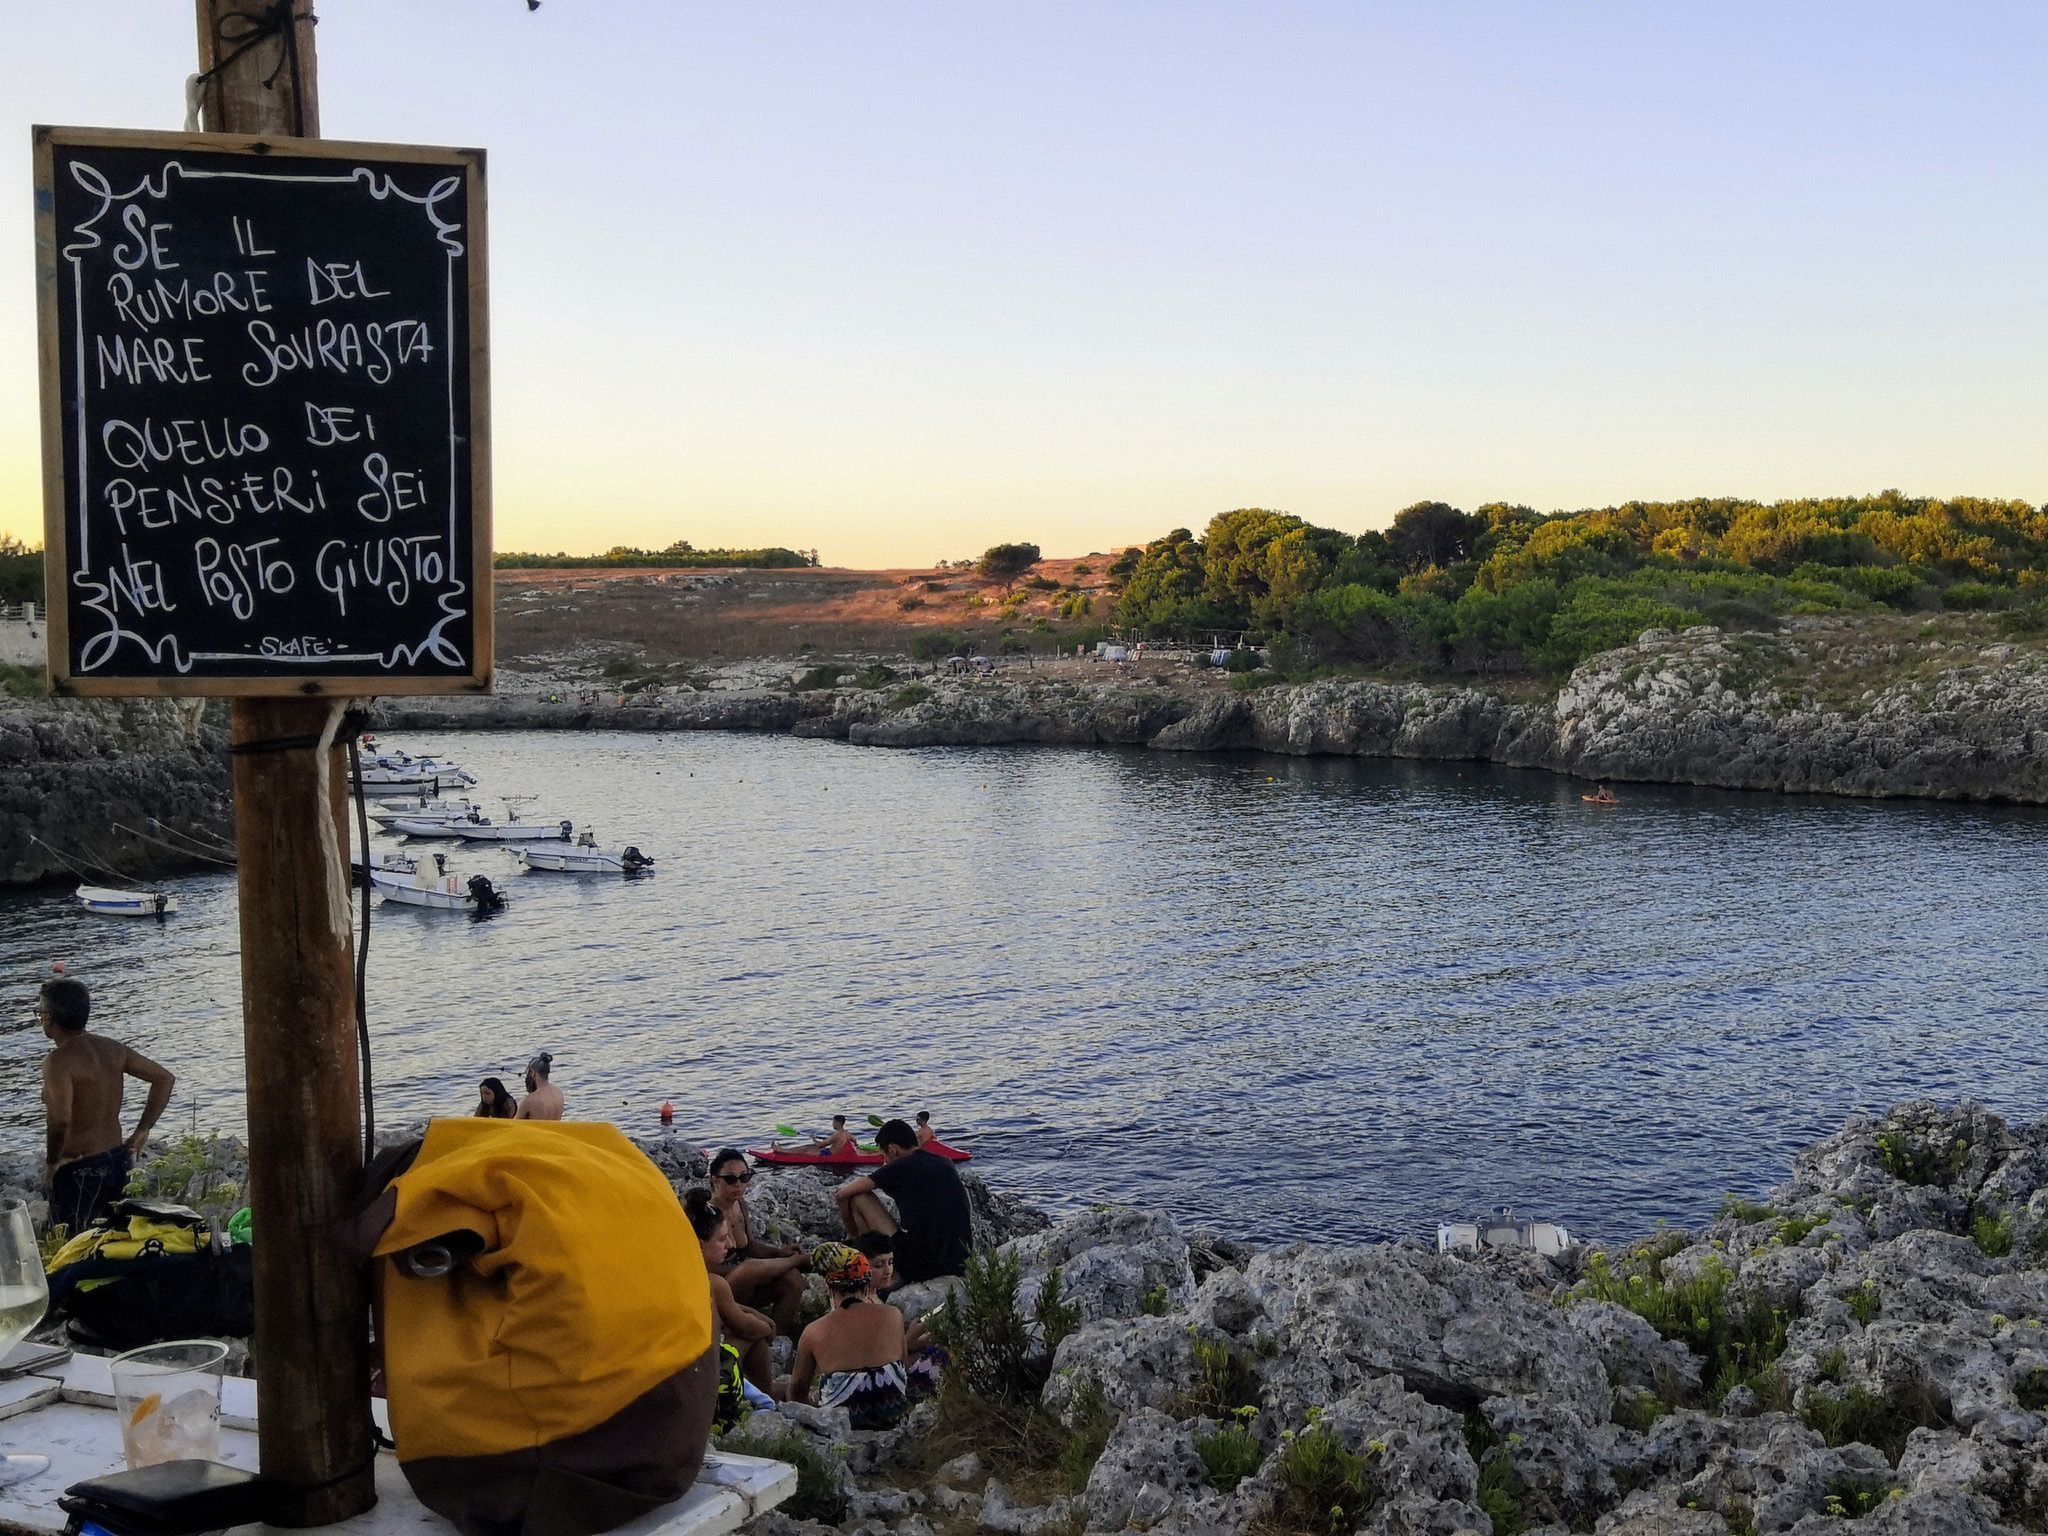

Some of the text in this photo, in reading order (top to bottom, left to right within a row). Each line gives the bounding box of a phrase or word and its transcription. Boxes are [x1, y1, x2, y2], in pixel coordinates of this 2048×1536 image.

[113, 204, 275, 270] SE IL
[307, 258, 390, 305] DEL
[97, 319, 433, 389] MARE SOVRASTA
[109, 542, 176, 617] NEL
[195, 537, 294, 619] POSTO
